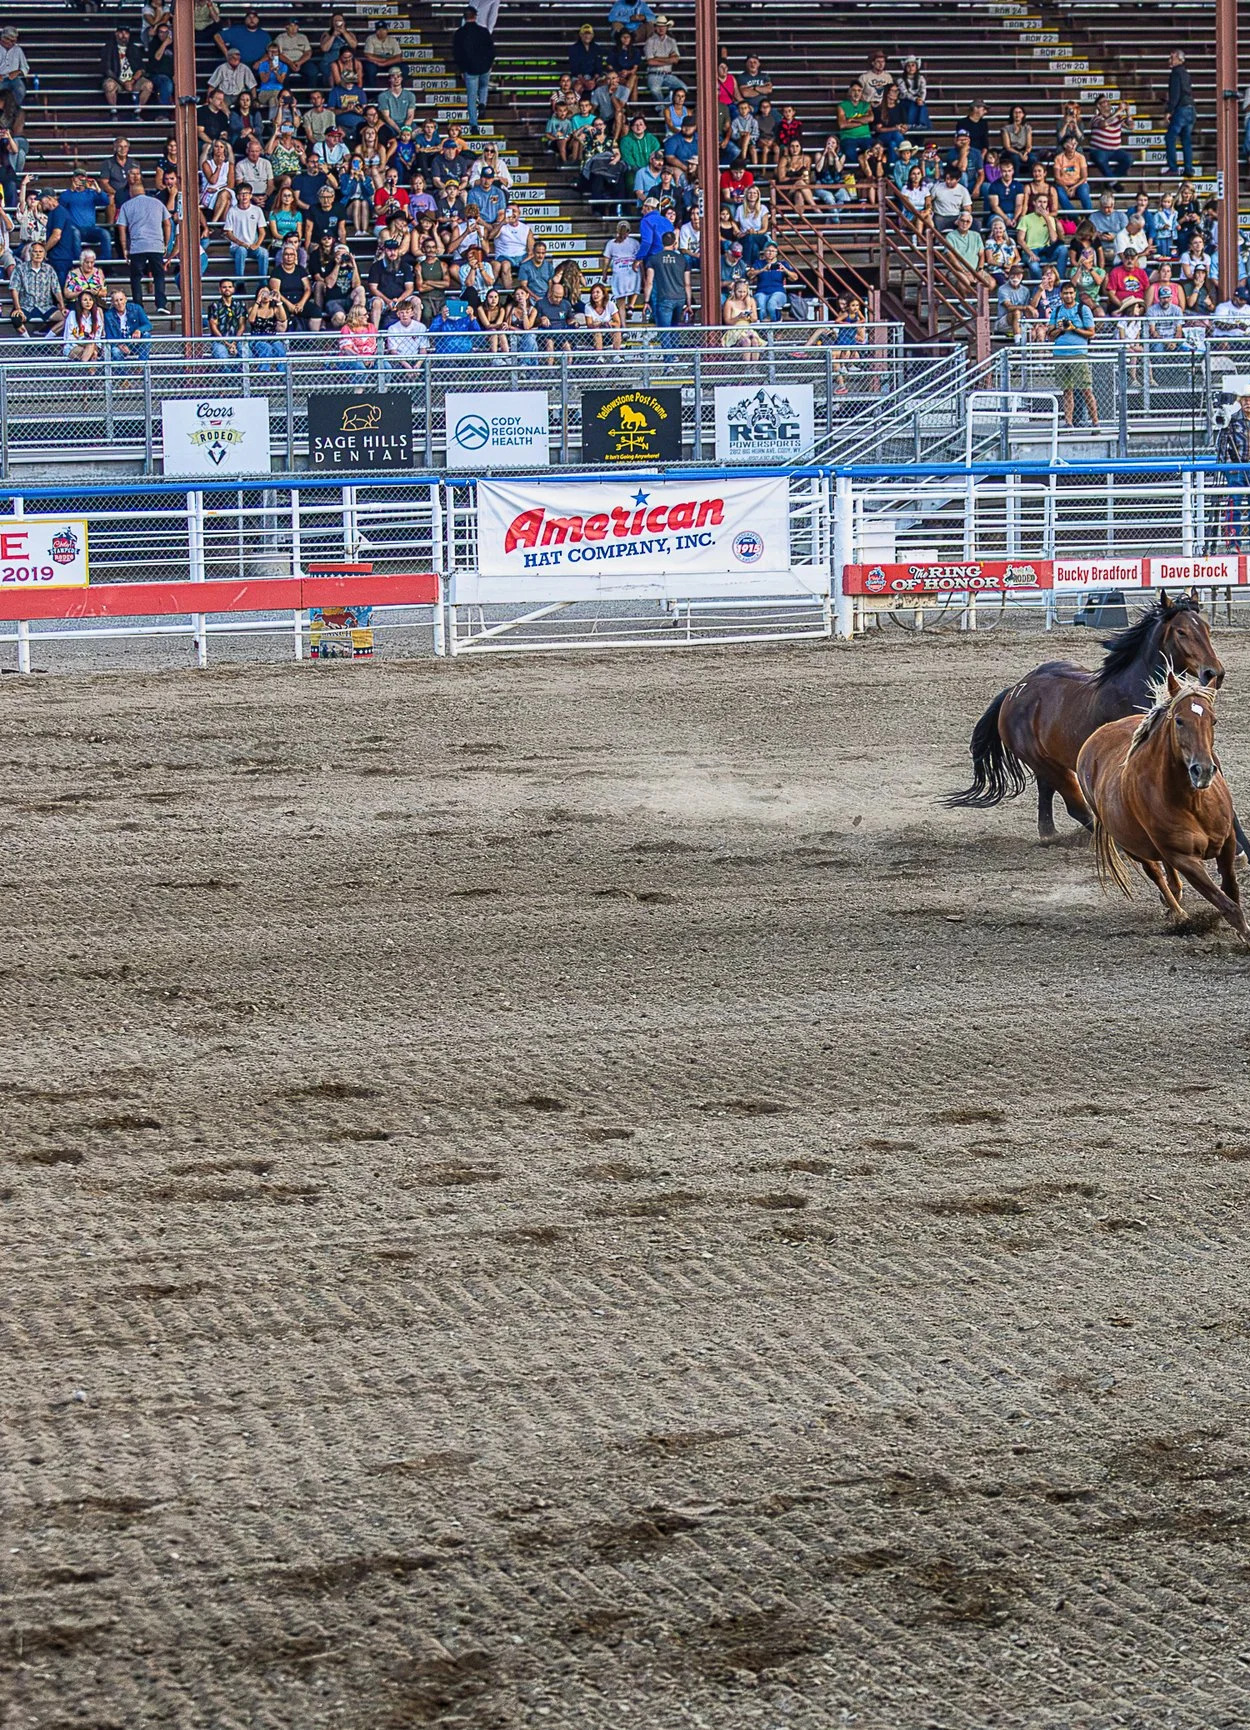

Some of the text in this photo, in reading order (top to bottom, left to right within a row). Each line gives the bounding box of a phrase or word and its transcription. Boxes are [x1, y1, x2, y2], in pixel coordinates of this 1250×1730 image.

[534, 224, 564, 232] ROW 10
[196, 402, 234, 418] Coors
[596, 392, 668, 420] Yellowstone Post Frame
[492, 417, 521, 426] CODY
[200, 431, 232, 442] RODEO
[492, 427, 547, 436] REGIONAL
[728, 423, 800, 441] RSC
[314, 434, 407, 449] SAGE HILLS
[492, 437, 532, 446] HEALTH
[730, 440, 801, 448] POWERSPORTS
[315, 449, 408, 463] DENTAL
[504, 498, 725, 554] American
[524, 532, 716, 568] HAT COMPANY, INC.
[736, 544, 761, 554] 1915
[2, 566, 54, 582] 2019
[909, 566, 982, 580] The RING
[1058, 565, 1138, 584] Bucky Bradford
[1161, 563, 1228, 578] Dave Brock
[891, 579, 921, 591] OF
[924, 578, 1000, 590] HONOR
